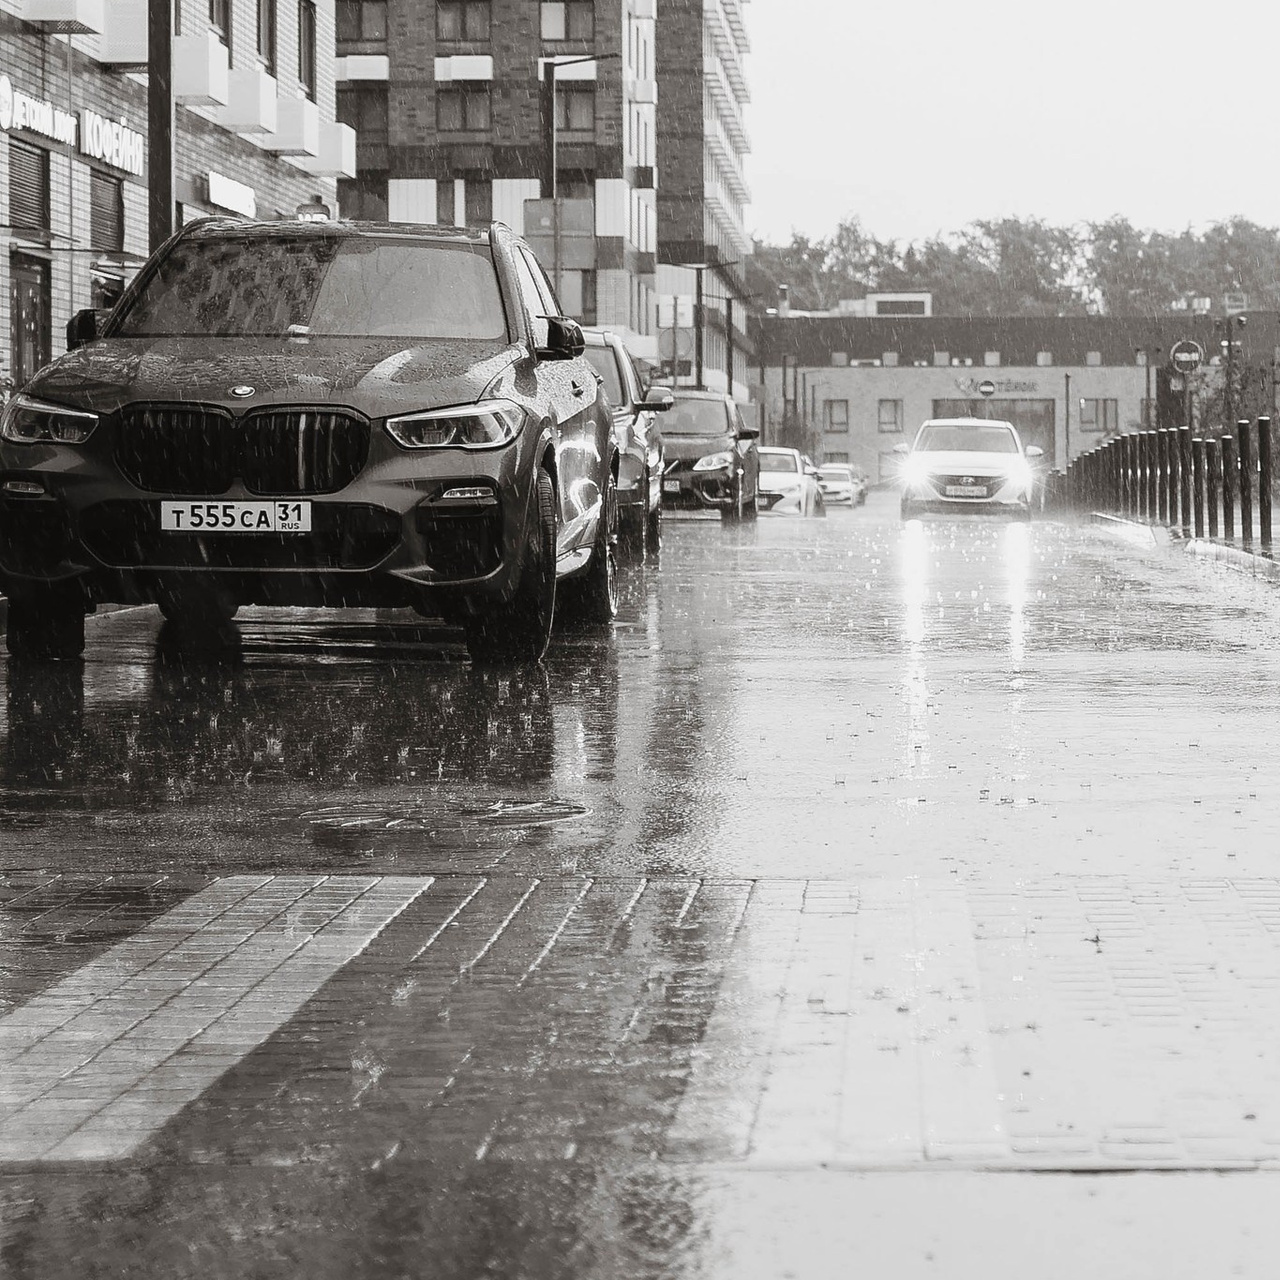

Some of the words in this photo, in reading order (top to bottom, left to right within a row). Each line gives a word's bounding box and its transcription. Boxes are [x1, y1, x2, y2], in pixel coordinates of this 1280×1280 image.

[12, 91, 53, 137] ДЕТСКИЙ
[84, 108, 144, 176] КОФЕЙНЯ
[278, 503, 302, 522] 31
[280, 522, 300, 530] RUS
